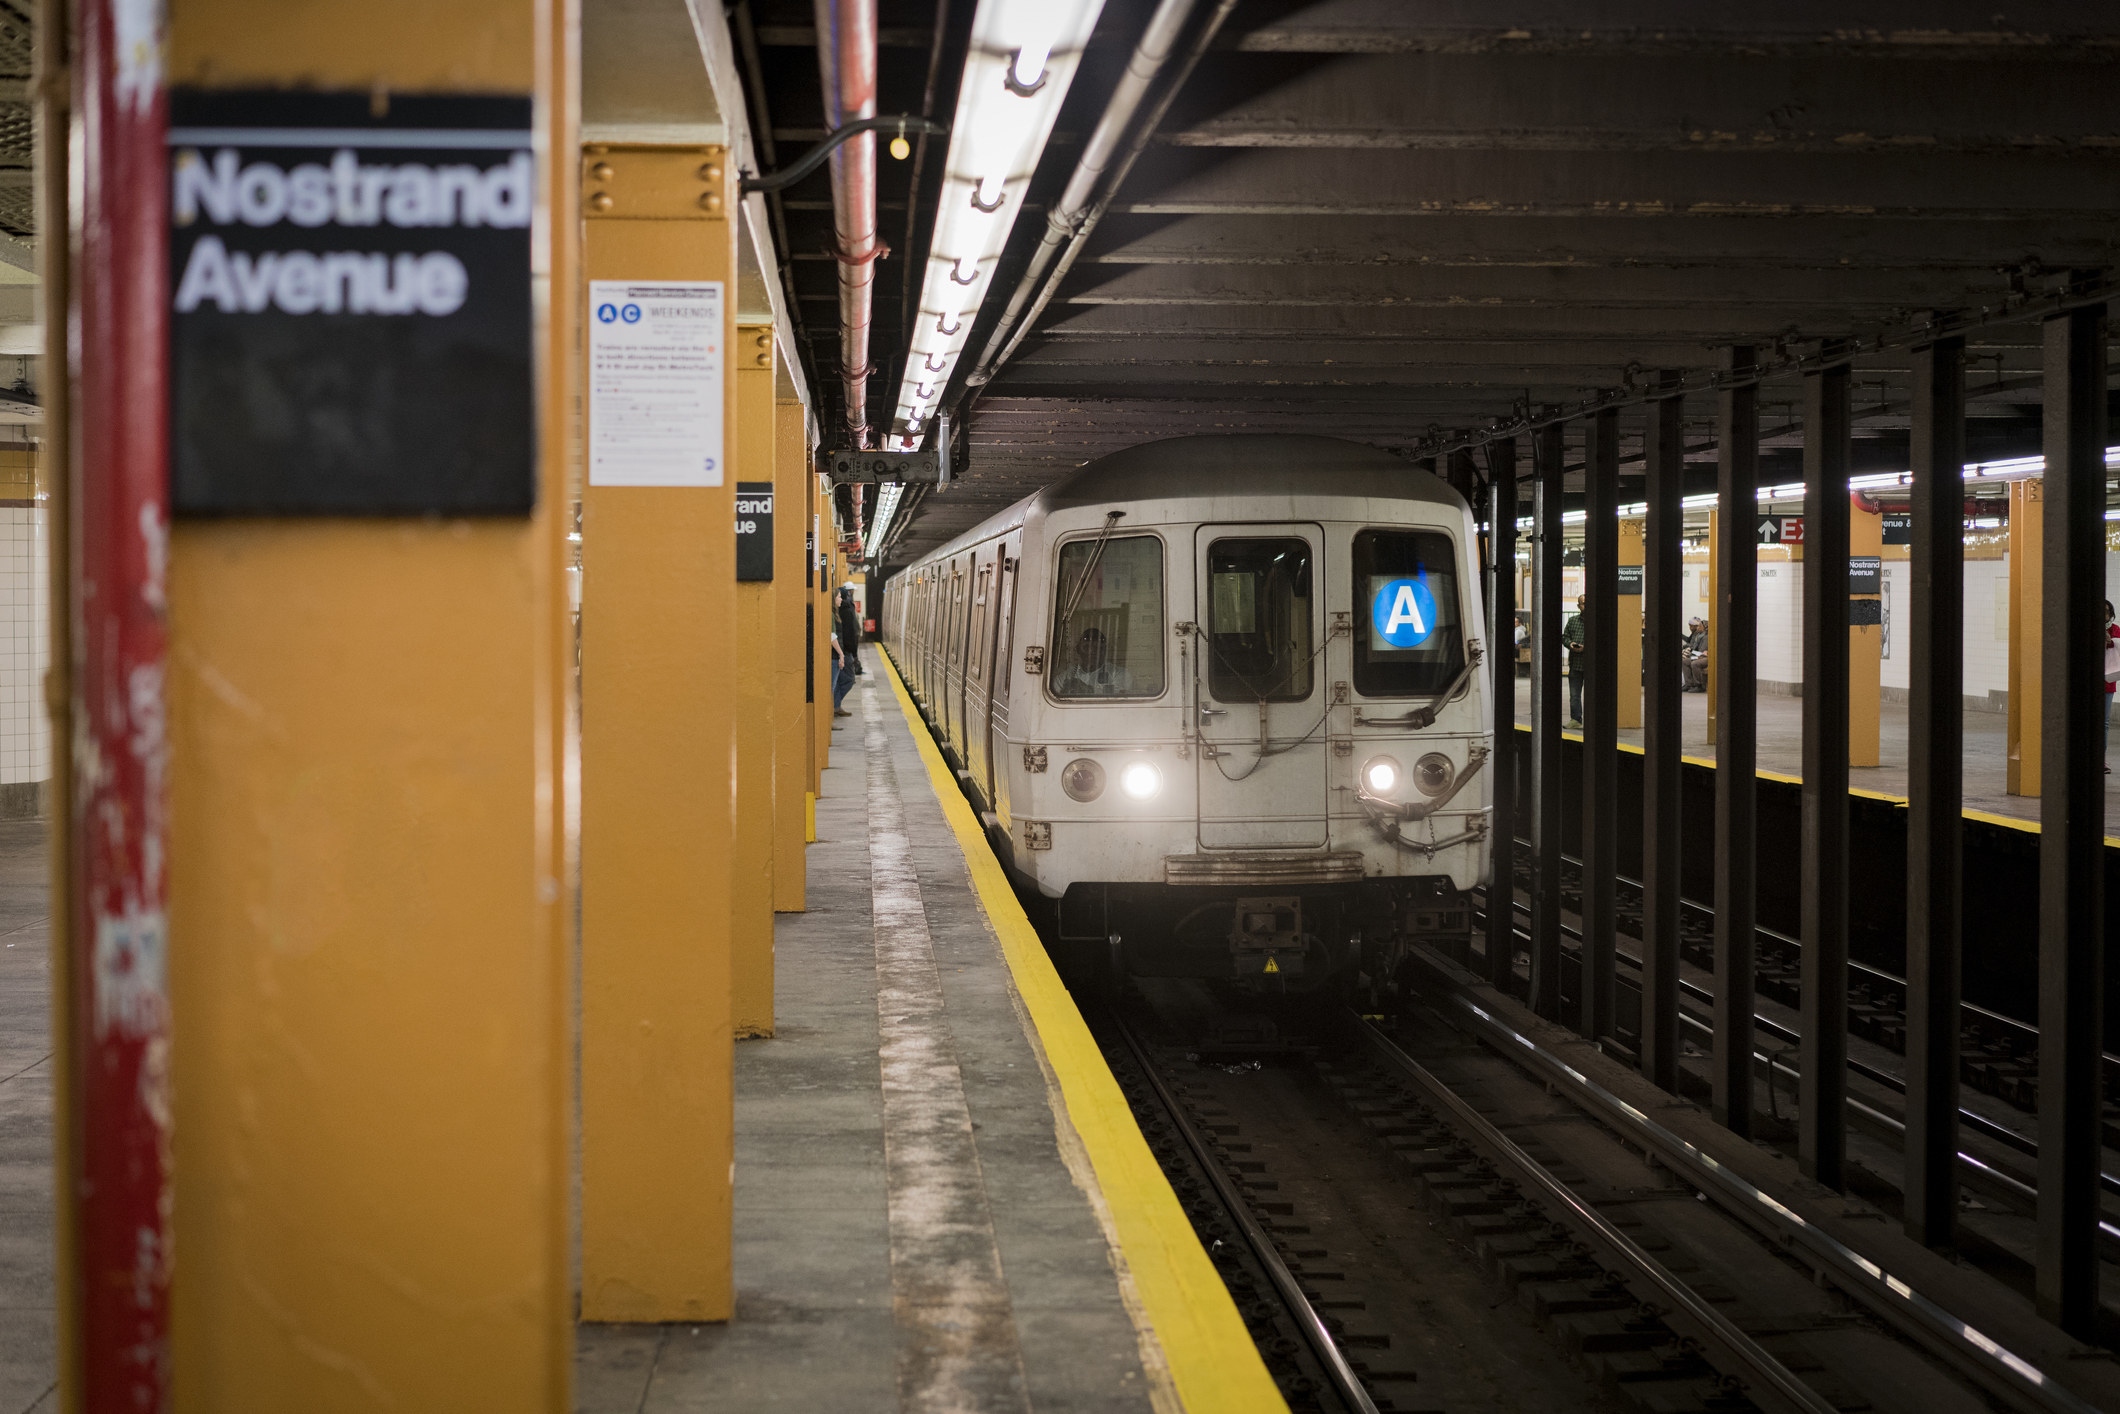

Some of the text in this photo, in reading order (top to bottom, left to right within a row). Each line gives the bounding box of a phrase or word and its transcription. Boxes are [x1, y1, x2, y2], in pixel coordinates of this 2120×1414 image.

[174, 147, 532, 228] Nostrand
[174, 234, 469, 316] Avenue
[600, 305, 715, 321] A C WEEKENDS
[733, 497, 772, 513] rand
[734, 521, 756, 534] ue
[1385, 586, 1425, 633] A
